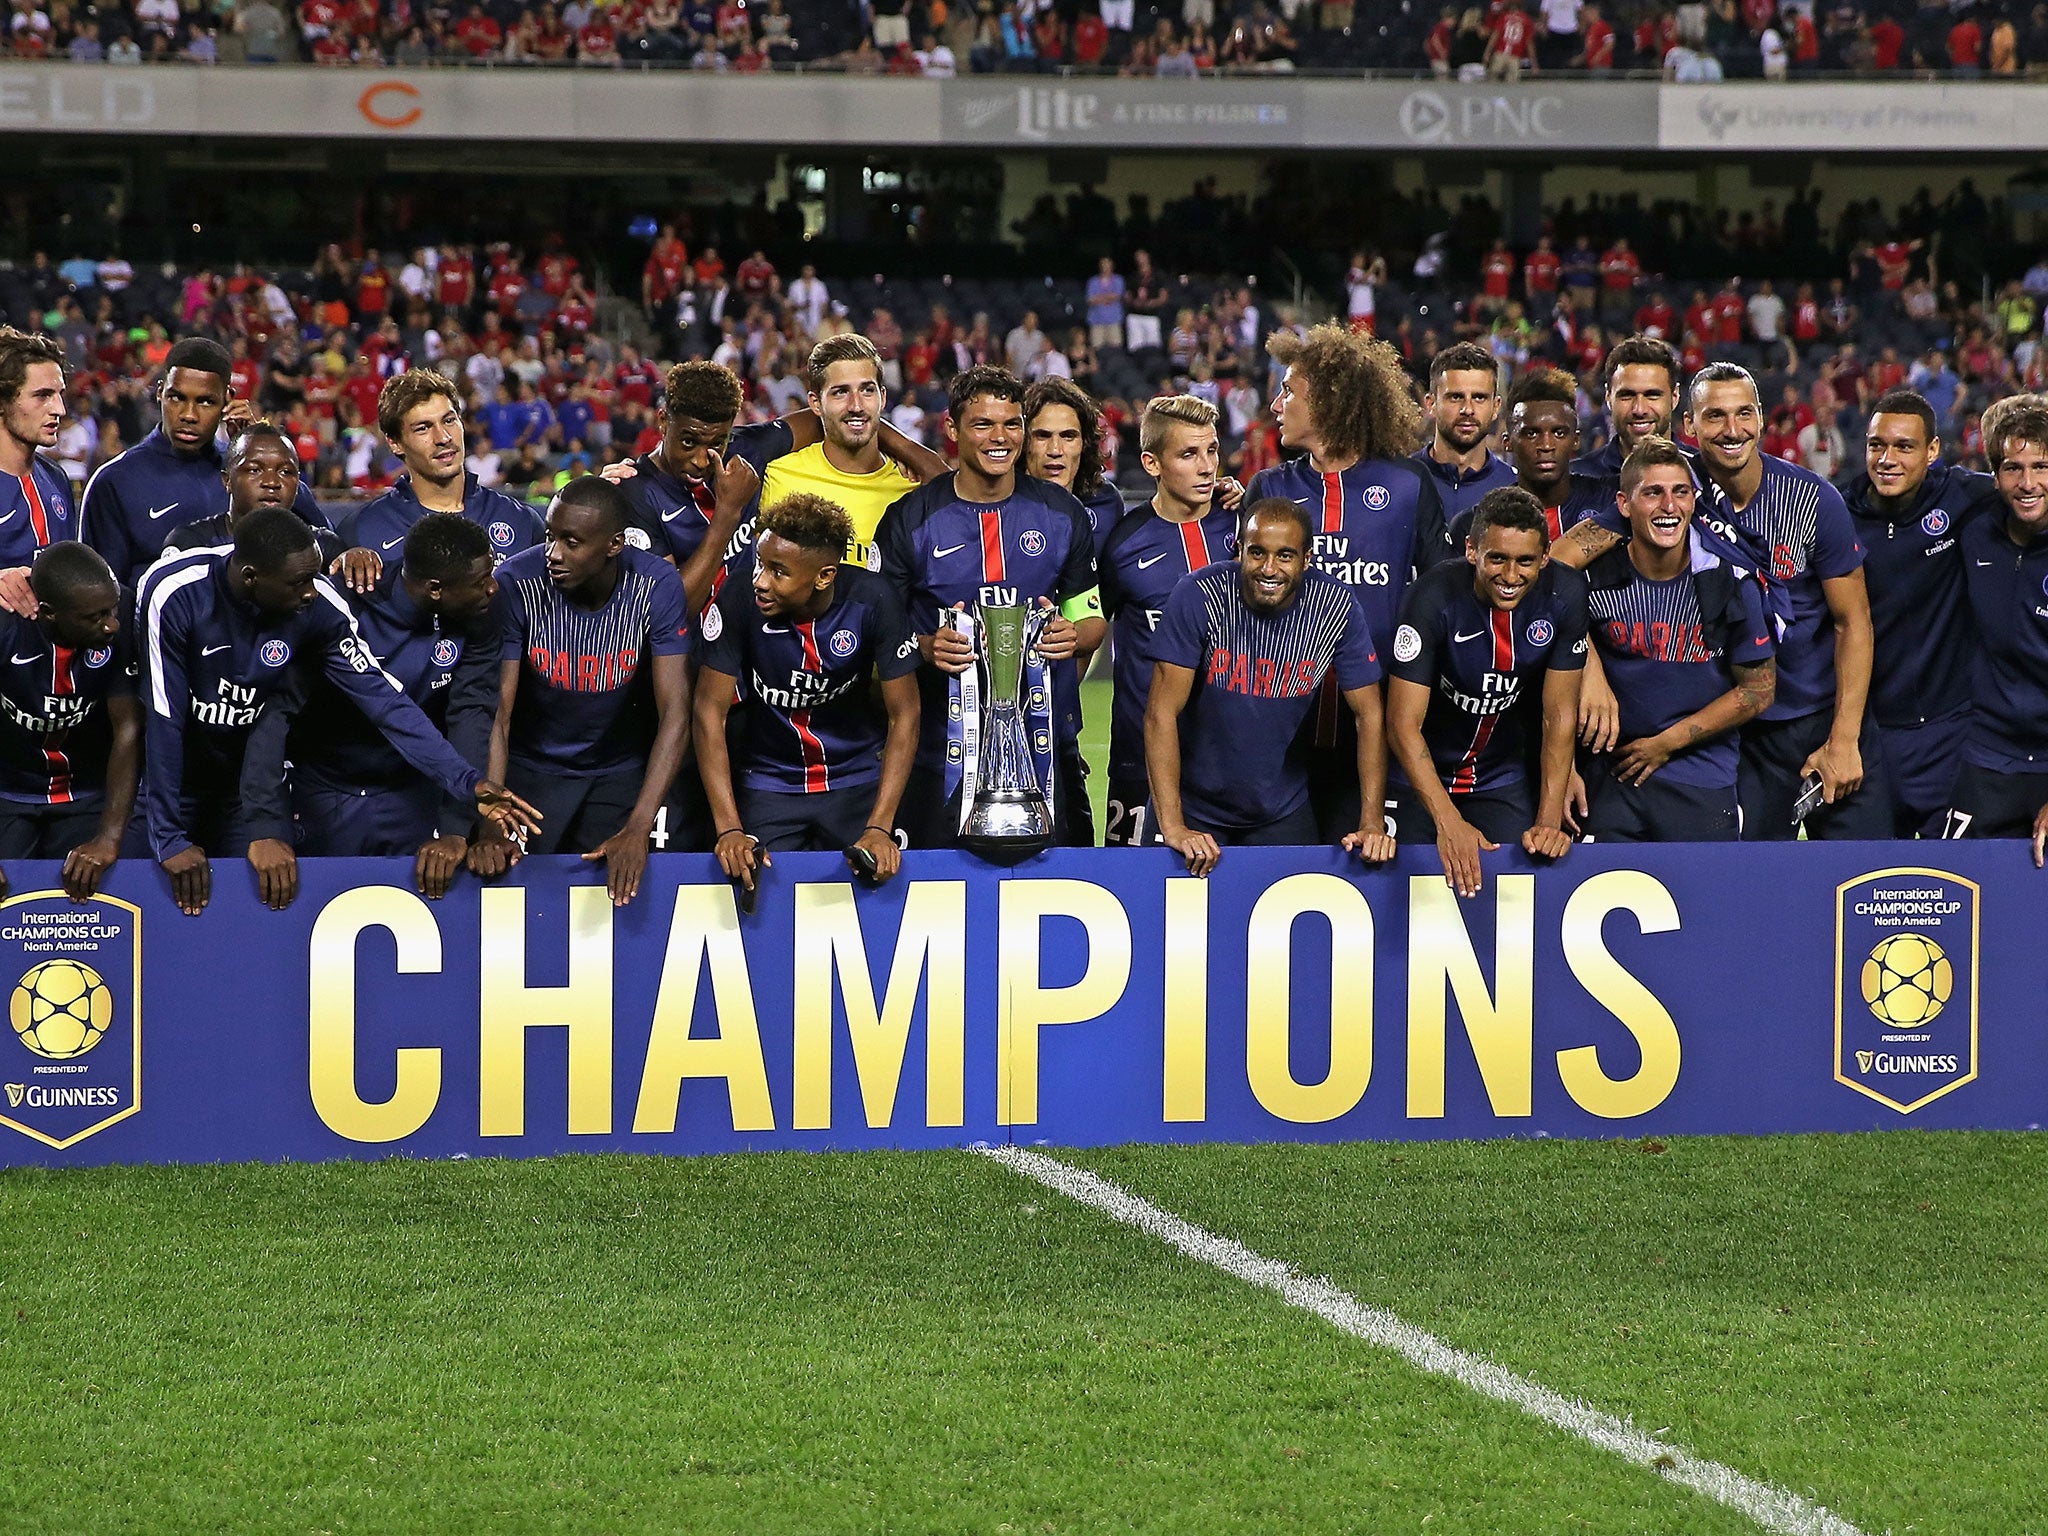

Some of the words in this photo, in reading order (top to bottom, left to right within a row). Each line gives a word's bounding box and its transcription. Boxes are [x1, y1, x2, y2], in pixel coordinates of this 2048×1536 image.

[1017, 86, 1099, 139] Lite
[1456, 97, 1563, 137] PNC
[1313, 535, 1349, 558] Fly
[979, 586, 1018, 608] Fly
[1608, 621, 1710, 662] PARIS
[339, 637, 369, 673] QNB
[530, 647, 637, 693] PARIS
[790, 669, 829, 693] Fly
[1207, 648, 1316, 697] PARIS
[218, 677, 256, 706] Fly
[1482, 673, 1518, 693] Fly
[44, 696, 84, 713] Fly
[1107, 800, 1146, 847] 21
[1942, 808, 1972, 840] 17
[1873, 888, 1943, 901] International
[22, 911, 100, 925] International
[1854, 903, 1933, 915] CHAMPIONS
[1934, 902, 1961, 915] CUP
[1874, 916, 1901, 926] North
[1902, 916, 1941, 926] America
[1, 926, 89, 940] CHAMPIONS
[90, 925, 121, 939] CUP
[24, 941, 53, 952] North
[55, 941, 98, 952] America
[308, 870, 1682, 1144] CHAMPIONS
[1881, 1034, 1920, 1042] PRESENTED
[1921, 1034, 1931, 1042] BY
[33, 1065, 77, 1075] PRESENTED
[78, 1065, 89, 1074] BY
[1874, 1052, 1958, 1074] GUINNESS
[26, 1085, 118, 1107] GUINNESS
